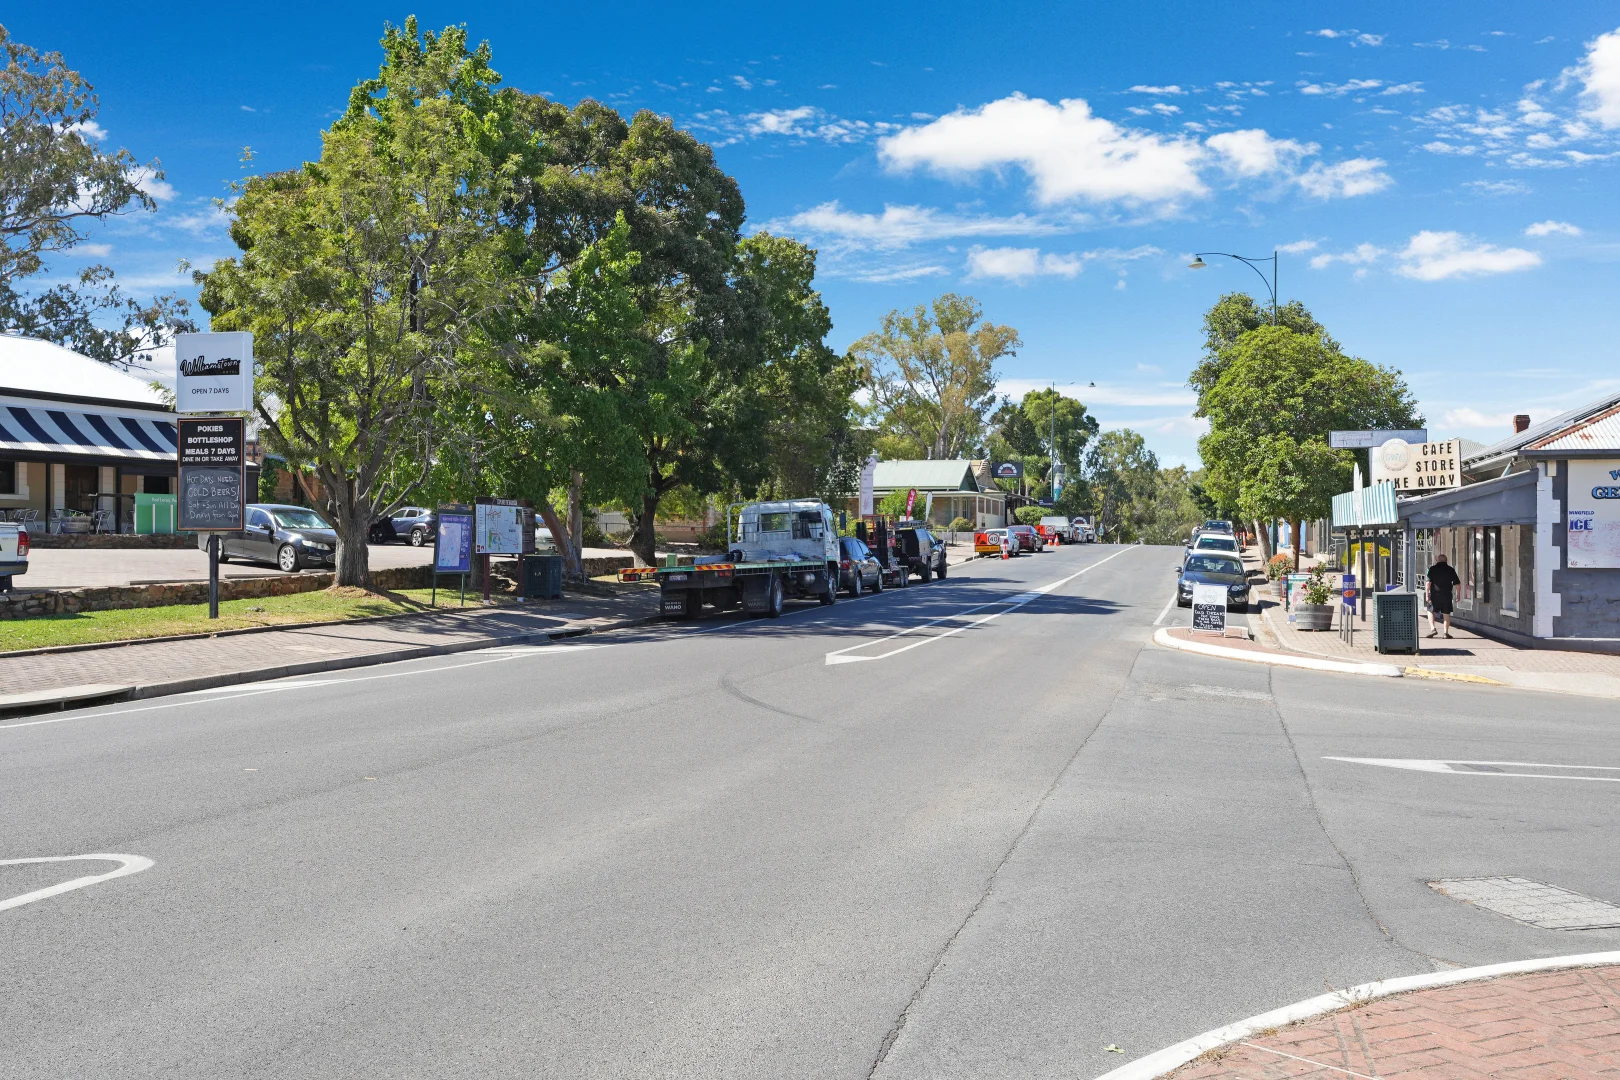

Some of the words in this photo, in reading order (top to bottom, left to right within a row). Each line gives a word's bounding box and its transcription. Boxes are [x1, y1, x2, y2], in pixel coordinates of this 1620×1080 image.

[187, 436, 234, 444] BOTTLESHOP
[217, 447, 236, 455] DAYS
[1422, 442, 1453, 456] CAFE
[1415, 459, 1455, 473] STORE
[186, 475, 199, 484] HOT
[1418, 474, 1455, 488] AWAY
[187, 487, 210, 498] COLD
[1591, 486, 1620, 500] GE
[907, 490, 916, 512] SALE
[1569, 518, 1593, 531] ICE
